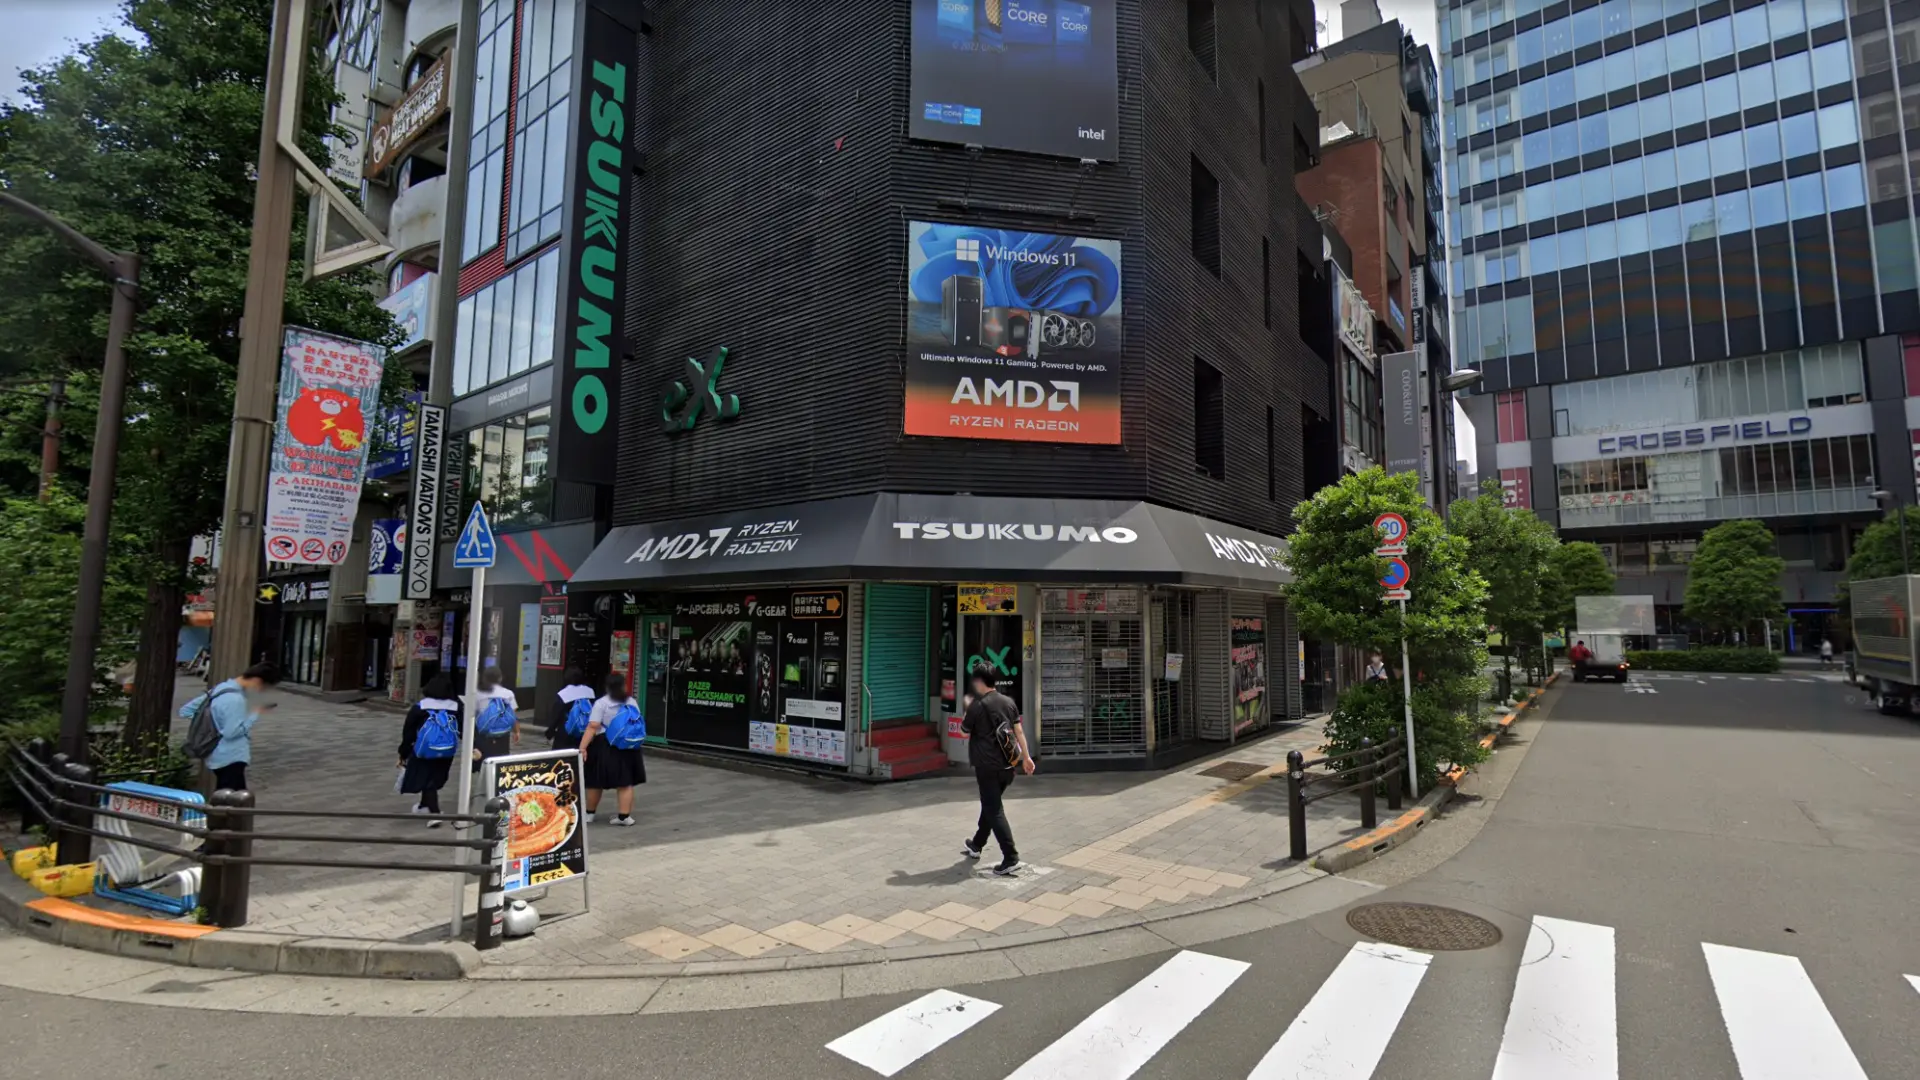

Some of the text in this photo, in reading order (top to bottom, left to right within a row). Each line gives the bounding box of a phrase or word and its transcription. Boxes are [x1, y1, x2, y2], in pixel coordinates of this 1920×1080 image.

[1078, 126, 1105, 141] intel
[572, 60, 627, 435] TSUKUMO
[986, 244, 1076, 267] Windows 11
[920, 353, 1108, 373] Ultimate Windows 11 Gaming. Powered by AMD.
[951, 376, 1046, 409] AMD
[949, 414, 1080, 433] RYZEN RADEON
[421, 410, 440, 473] TAMASHII
[283, 447, 361, 467] Welcome!
[291, 476, 358, 493] AKIHABARA
[416, 471, 436, 536] NATIONS
[736, 518, 800, 538] RYZEN
[893, 522, 1139, 545] TSUKUMO
[624, 533, 701, 564] AMD
[723, 538, 800, 556] RADEON
[1205, 532, 1256, 564] AMD
[411, 539, 431, 594] TOKYO
[676, 603, 741, 616] ゲームPCお探しなら
[687, 681, 711, 692] RAZER
[687, 689, 746, 704] BLACKSHARK V2
[534, 870, 565, 884] すぐそこ
